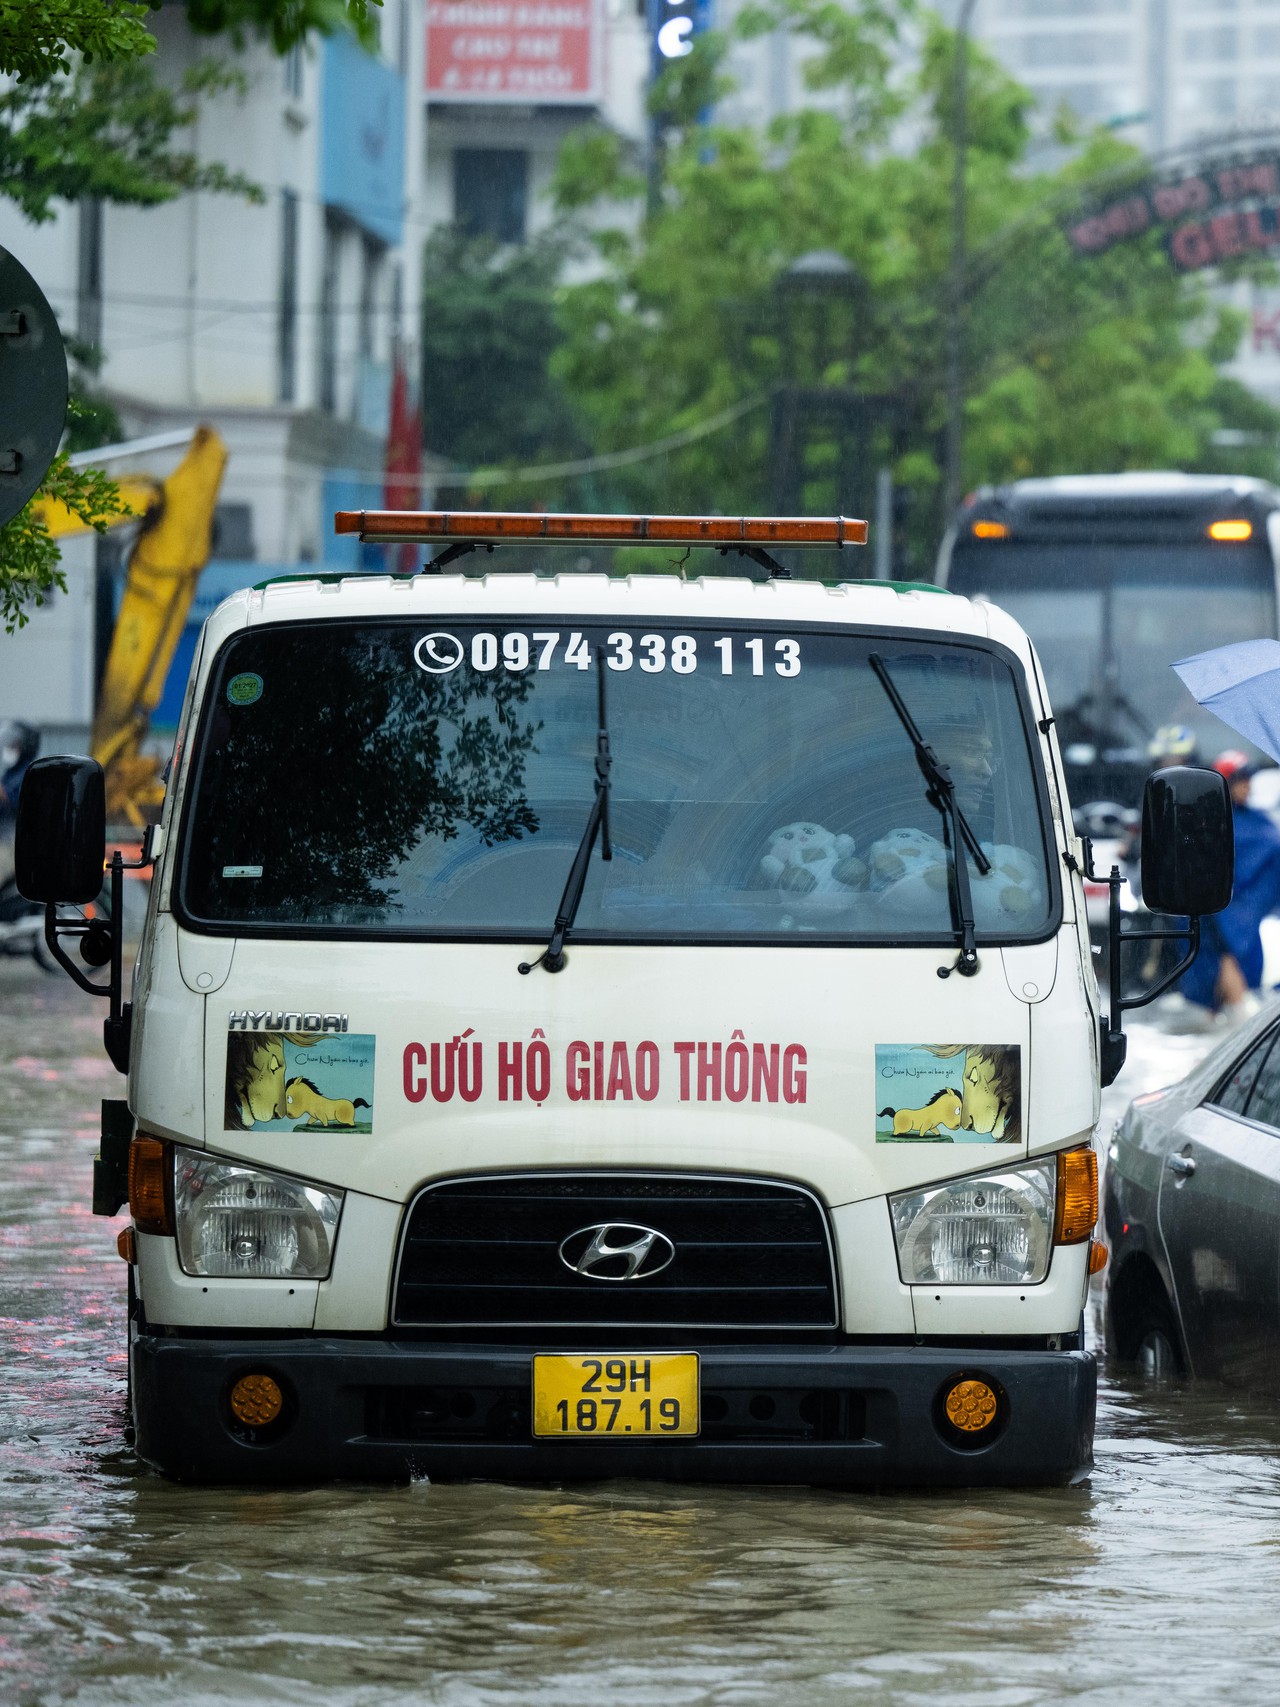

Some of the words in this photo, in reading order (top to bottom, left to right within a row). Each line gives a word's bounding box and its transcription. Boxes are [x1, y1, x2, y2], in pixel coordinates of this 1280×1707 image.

[471, 632, 592, 672] 0974
[606, 632, 698, 674] 338
[713, 637, 802, 678] 113
[228, 1010, 349, 1032] HYUNDAI
[498, 1027, 551, 1107] HỘ
[566, 1040, 660, 1102] GIAO
[673, 1029, 808, 1104] THÔNG
[581, 1359, 651, 1393] 29H
[556, 1398, 680, 1432] 187.19
